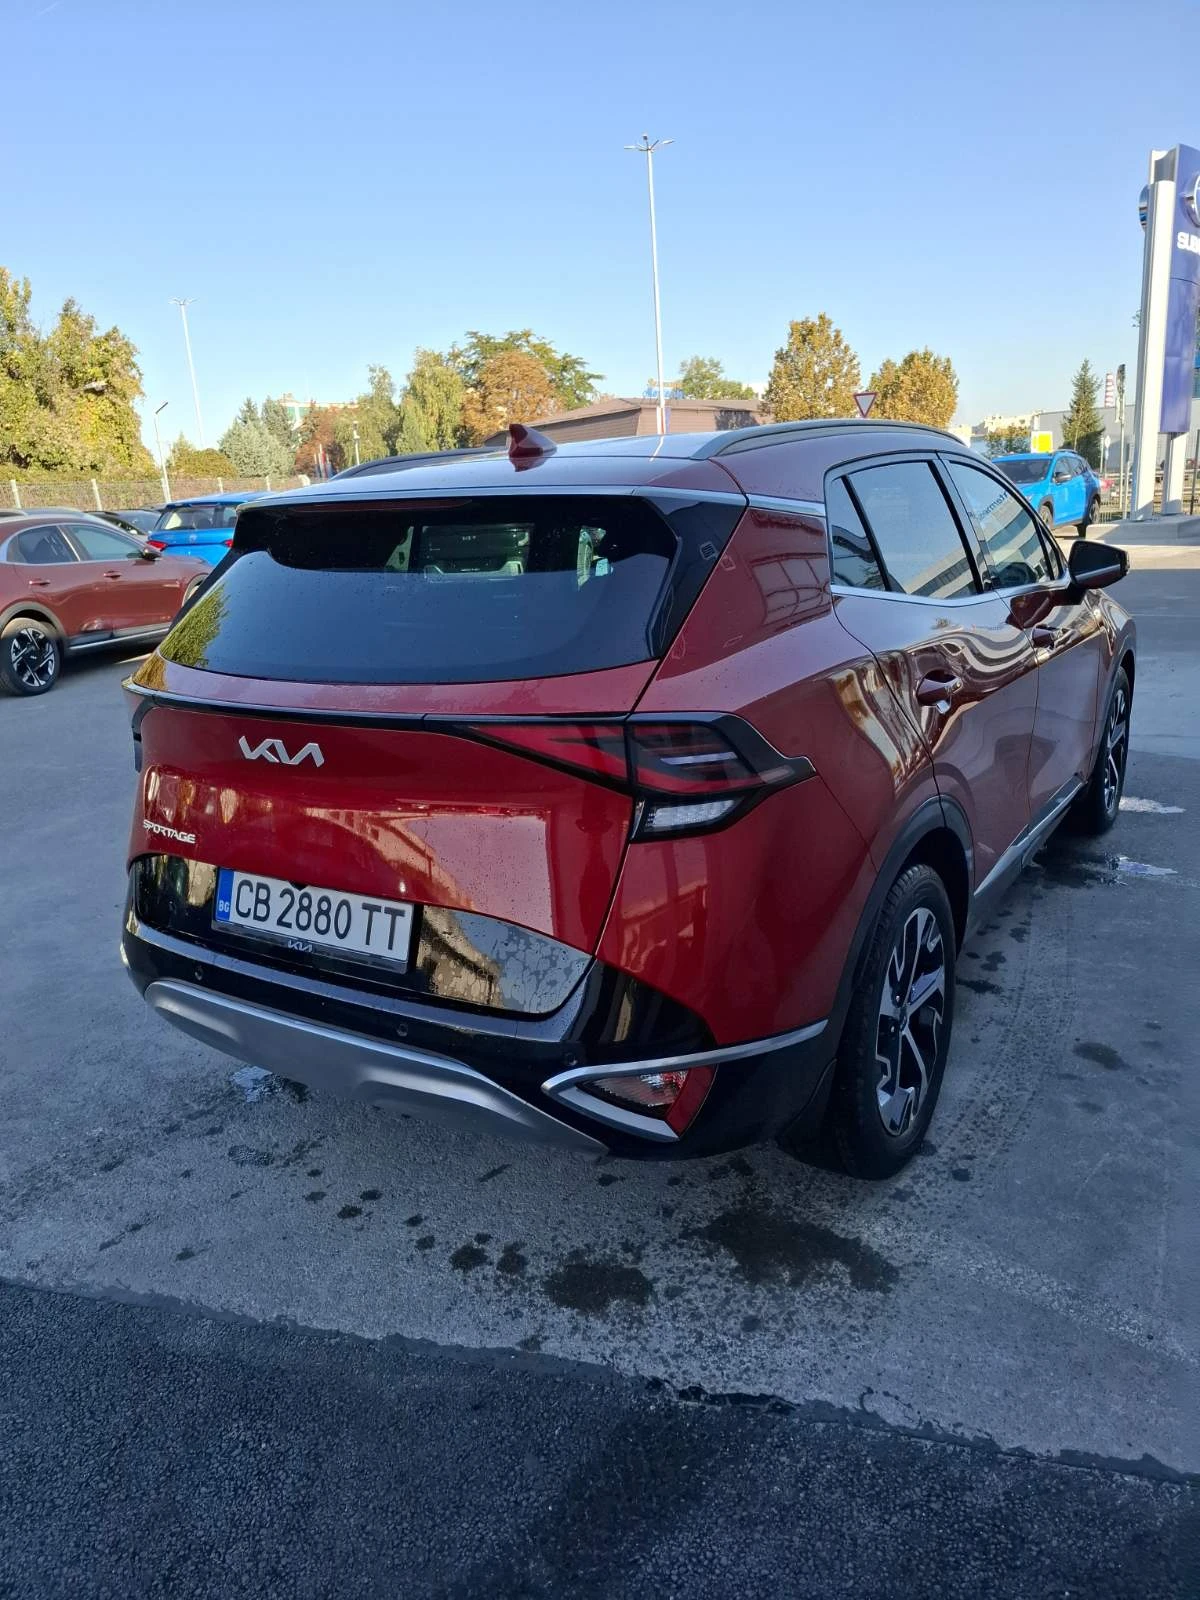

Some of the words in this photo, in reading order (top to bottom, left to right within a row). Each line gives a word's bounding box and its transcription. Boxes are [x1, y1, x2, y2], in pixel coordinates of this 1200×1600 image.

[238, 735, 325, 767] KIA
[143, 819, 196, 844] SPORTAGE
[218, 901, 230, 913] BG
[235, 879, 271, 922] CB
[276, 888, 352, 940] 2880
[362, 902, 406, 950] TT
